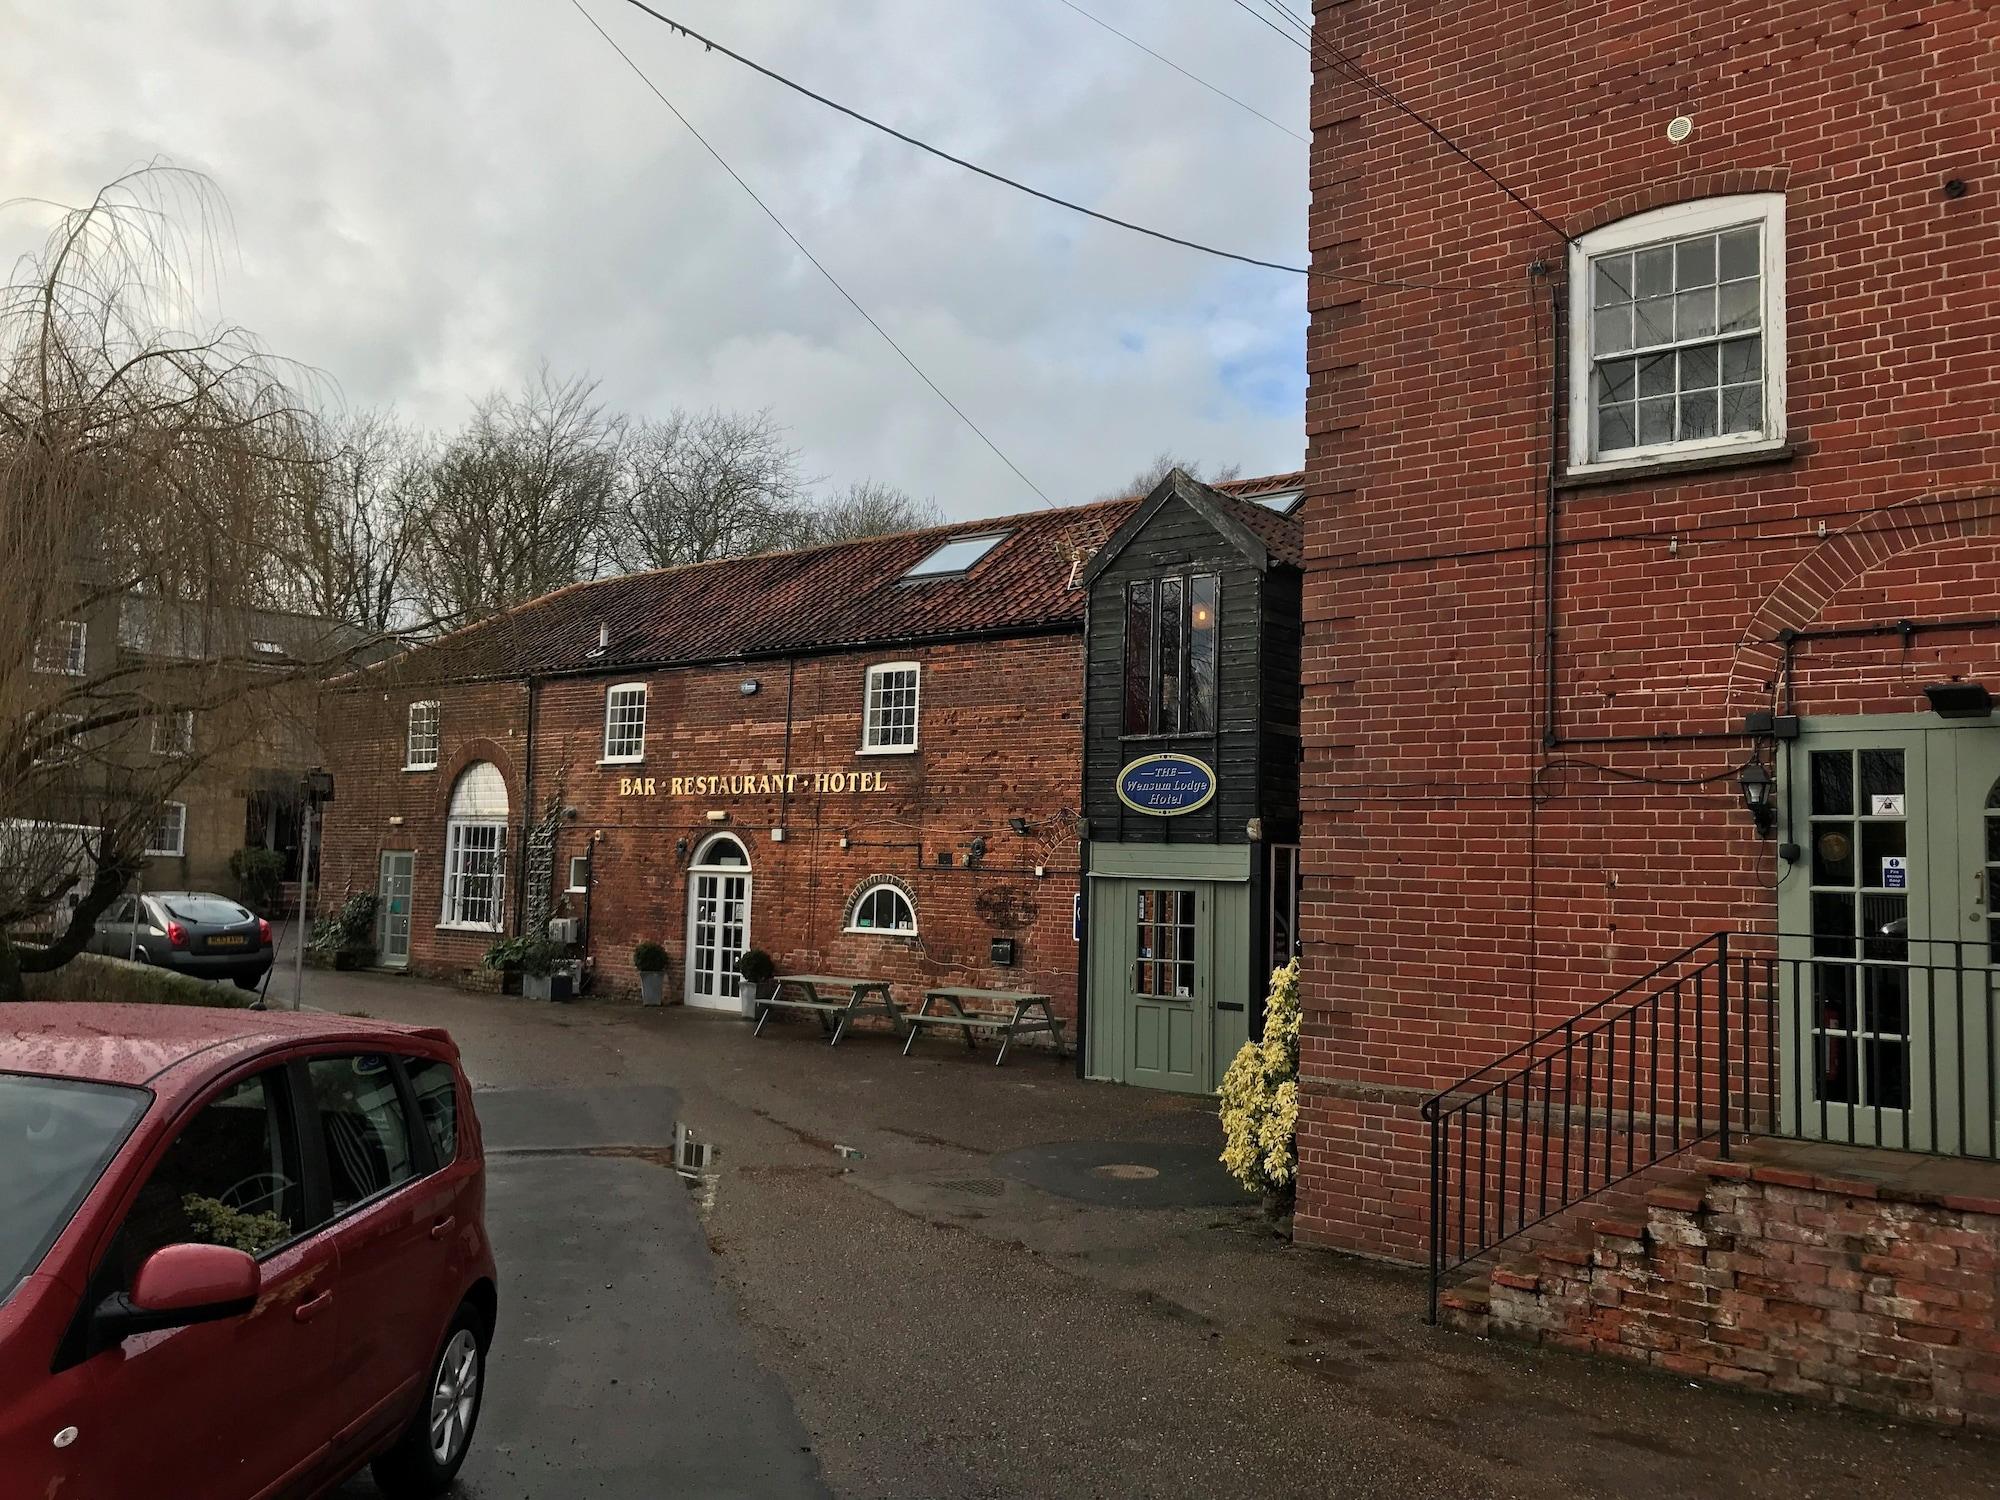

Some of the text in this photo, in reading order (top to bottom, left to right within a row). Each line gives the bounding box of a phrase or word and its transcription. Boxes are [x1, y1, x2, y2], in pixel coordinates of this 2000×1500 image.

[1154, 767, 1178, 777] THE
[620, 772, 888, 796] BAR RESTAURANT HOTEL
[1127, 780, 1208, 792] Wensum Lodge
[1148, 793, 1183, 805] Hotel
